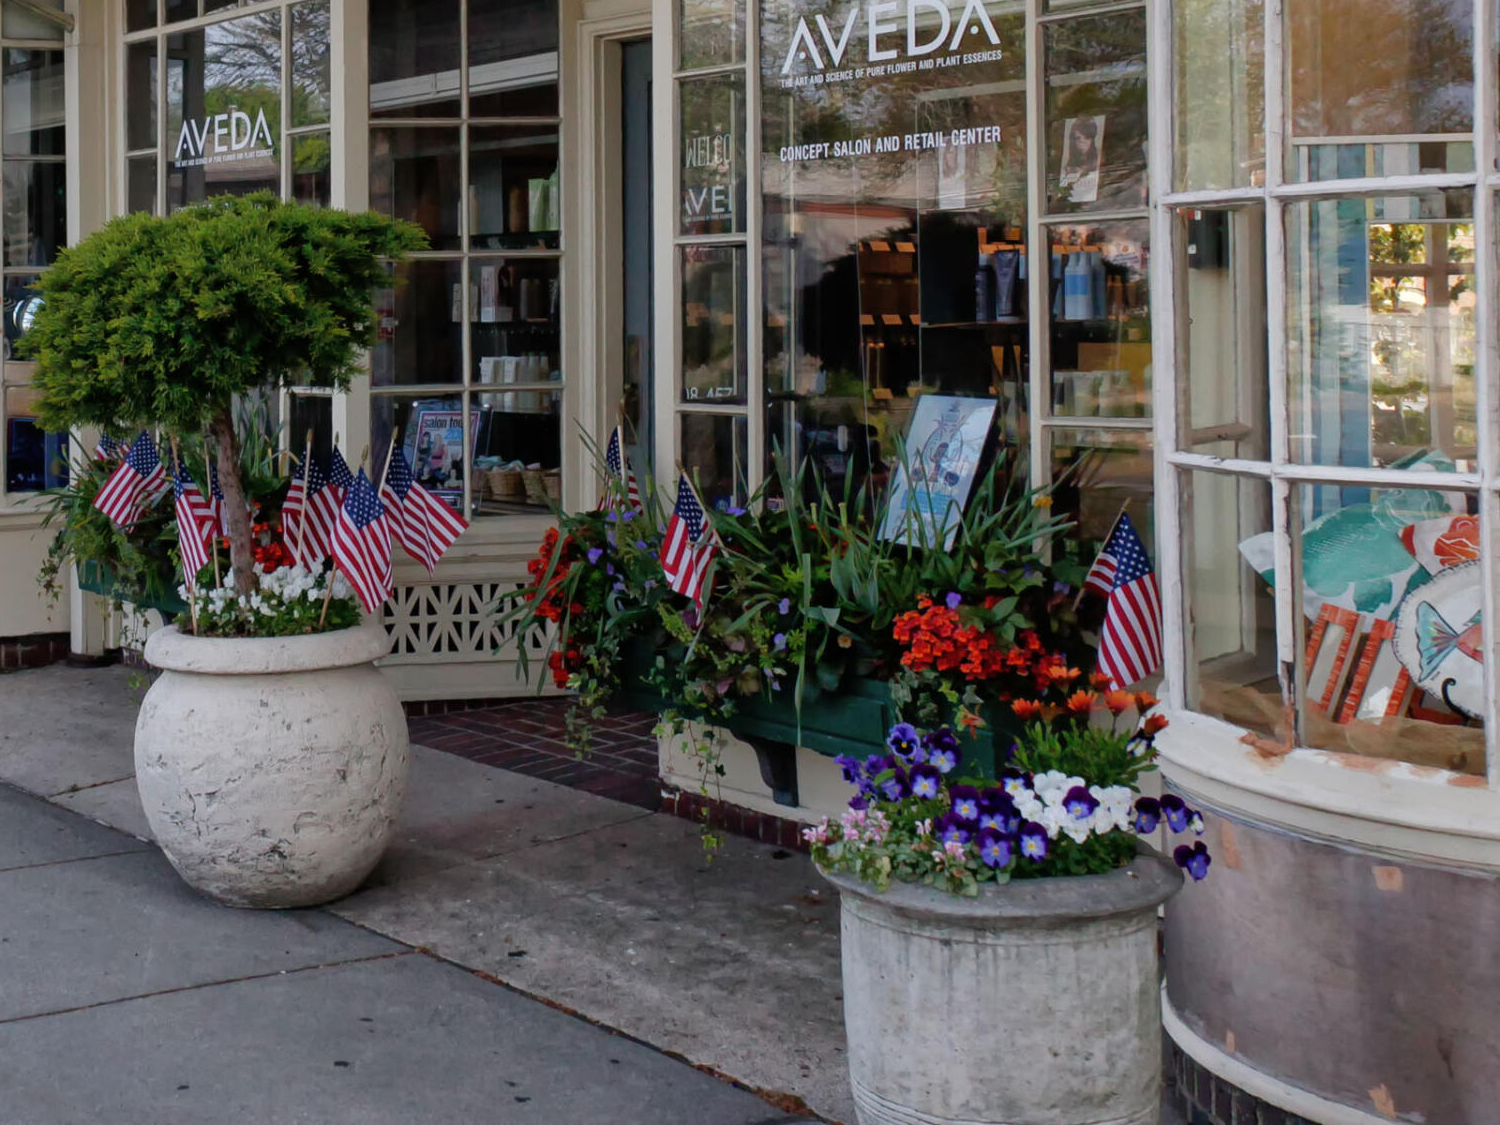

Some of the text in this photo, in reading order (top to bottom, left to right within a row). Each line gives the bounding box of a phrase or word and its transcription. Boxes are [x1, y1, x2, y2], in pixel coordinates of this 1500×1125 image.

[781, 49, 1002, 89] THE ART AND SCIENCE OF PURE FLOWER AND PLANT ESSENCES
[175, 107, 273, 158] AVEDA
[780, 125, 1001, 162] CONCEPT SALON AND RETAIL CENTER
